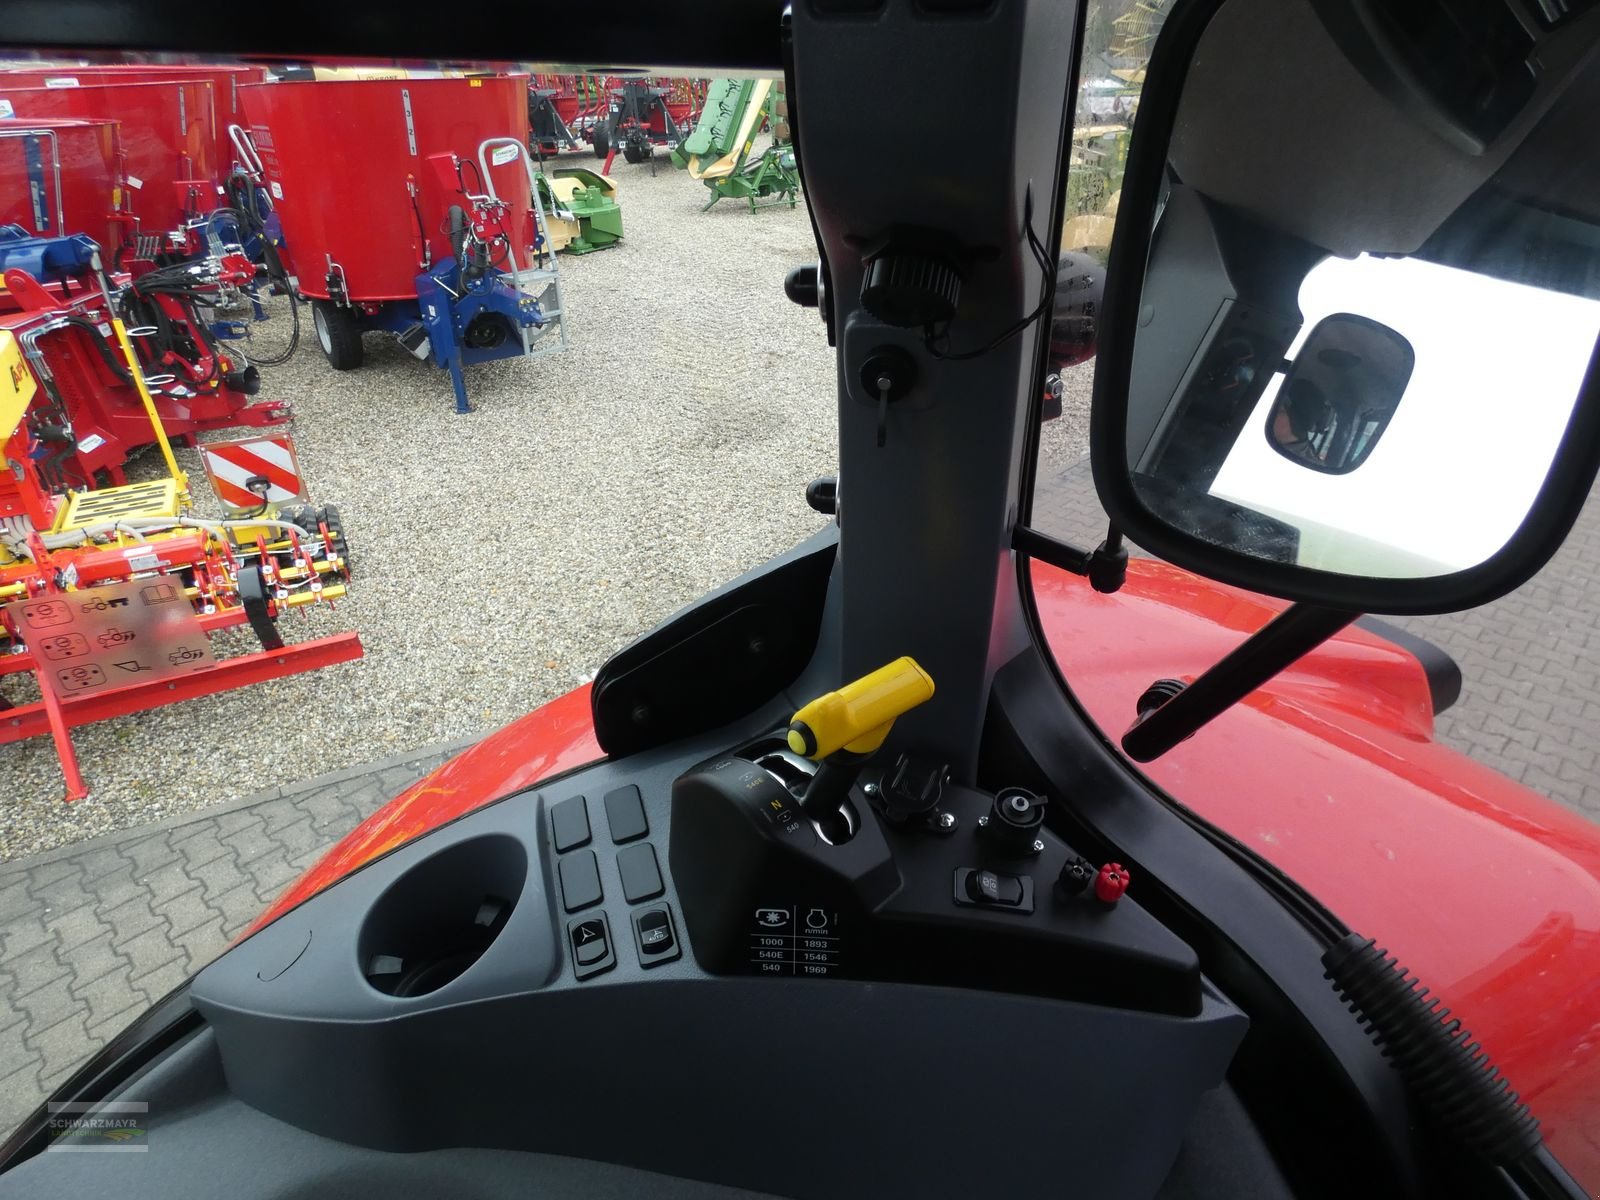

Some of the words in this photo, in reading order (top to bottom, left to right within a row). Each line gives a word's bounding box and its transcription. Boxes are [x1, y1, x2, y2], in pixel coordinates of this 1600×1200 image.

[409, 128, 414, 136] 2
[771, 799, 783, 811] N
[786, 822, 800, 833] 540
[760, 938, 783, 946] 1000
[804, 940, 828, 949] 1893
[759, 951, 783, 959] 540E
[804, 953, 828, 961] 1546
[762, 963, 780, 971] 540
[804, 966, 827, 974] 1969
